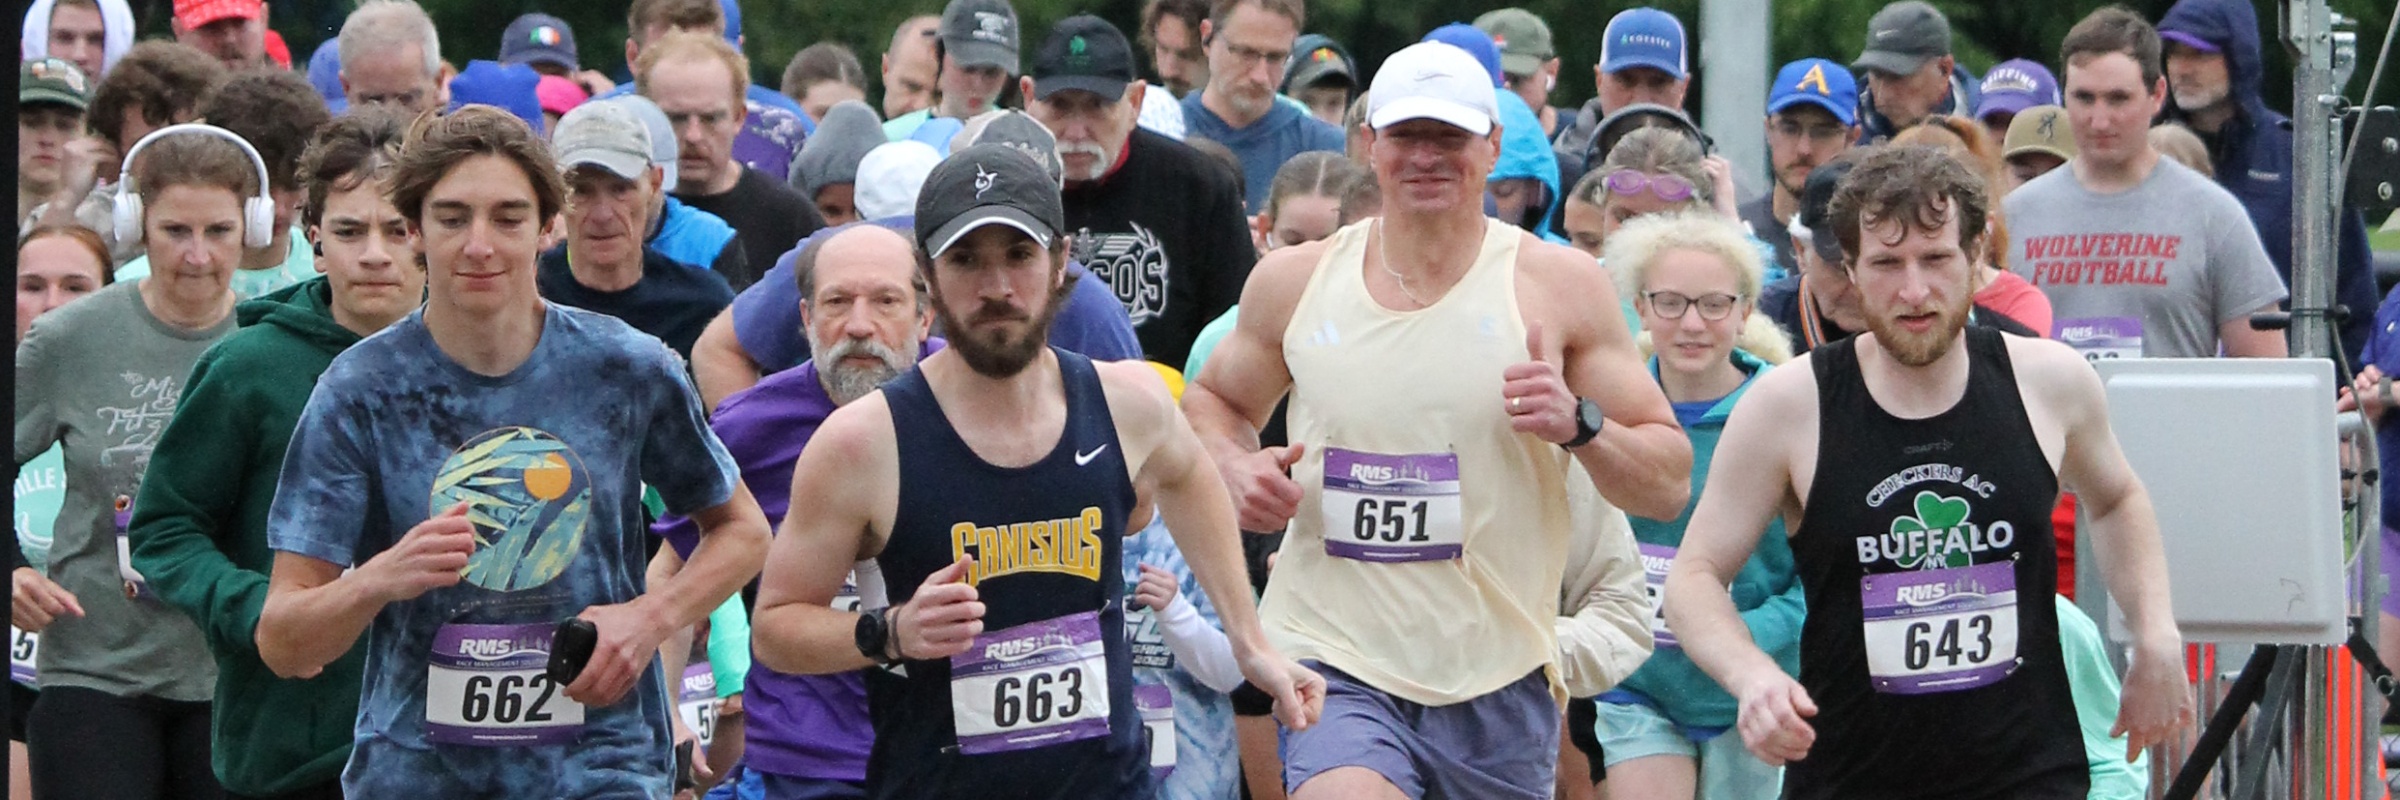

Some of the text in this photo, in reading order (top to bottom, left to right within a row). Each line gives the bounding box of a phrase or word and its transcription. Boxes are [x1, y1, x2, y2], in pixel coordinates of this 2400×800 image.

[1795, 63, 1830, 96] A
[2025, 233, 2182, 261] WOLVERINE
[2031, 260, 2168, 287] FOOTBALL
[2061, 326, 2093, 338] RMS
[1350, 463, 1393, 480] RMS
[1866, 463, 1996, 507] CHECKERS AC
[1353, 498, 1430, 542] 651
[951, 506, 1102, 588] CANISIUS
[1856, 520, 2014, 563] BUFFALO
[1896, 582, 1946, 602] RMS
[459, 639, 511, 654] RMS
[985, 637, 1034, 659] RMS
[1904, 614, 1992, 670] 643
[683, 672, 714, 689] RMS
[462, 674, 556, 723] 662
[994, 667, 1082, 728] 663
